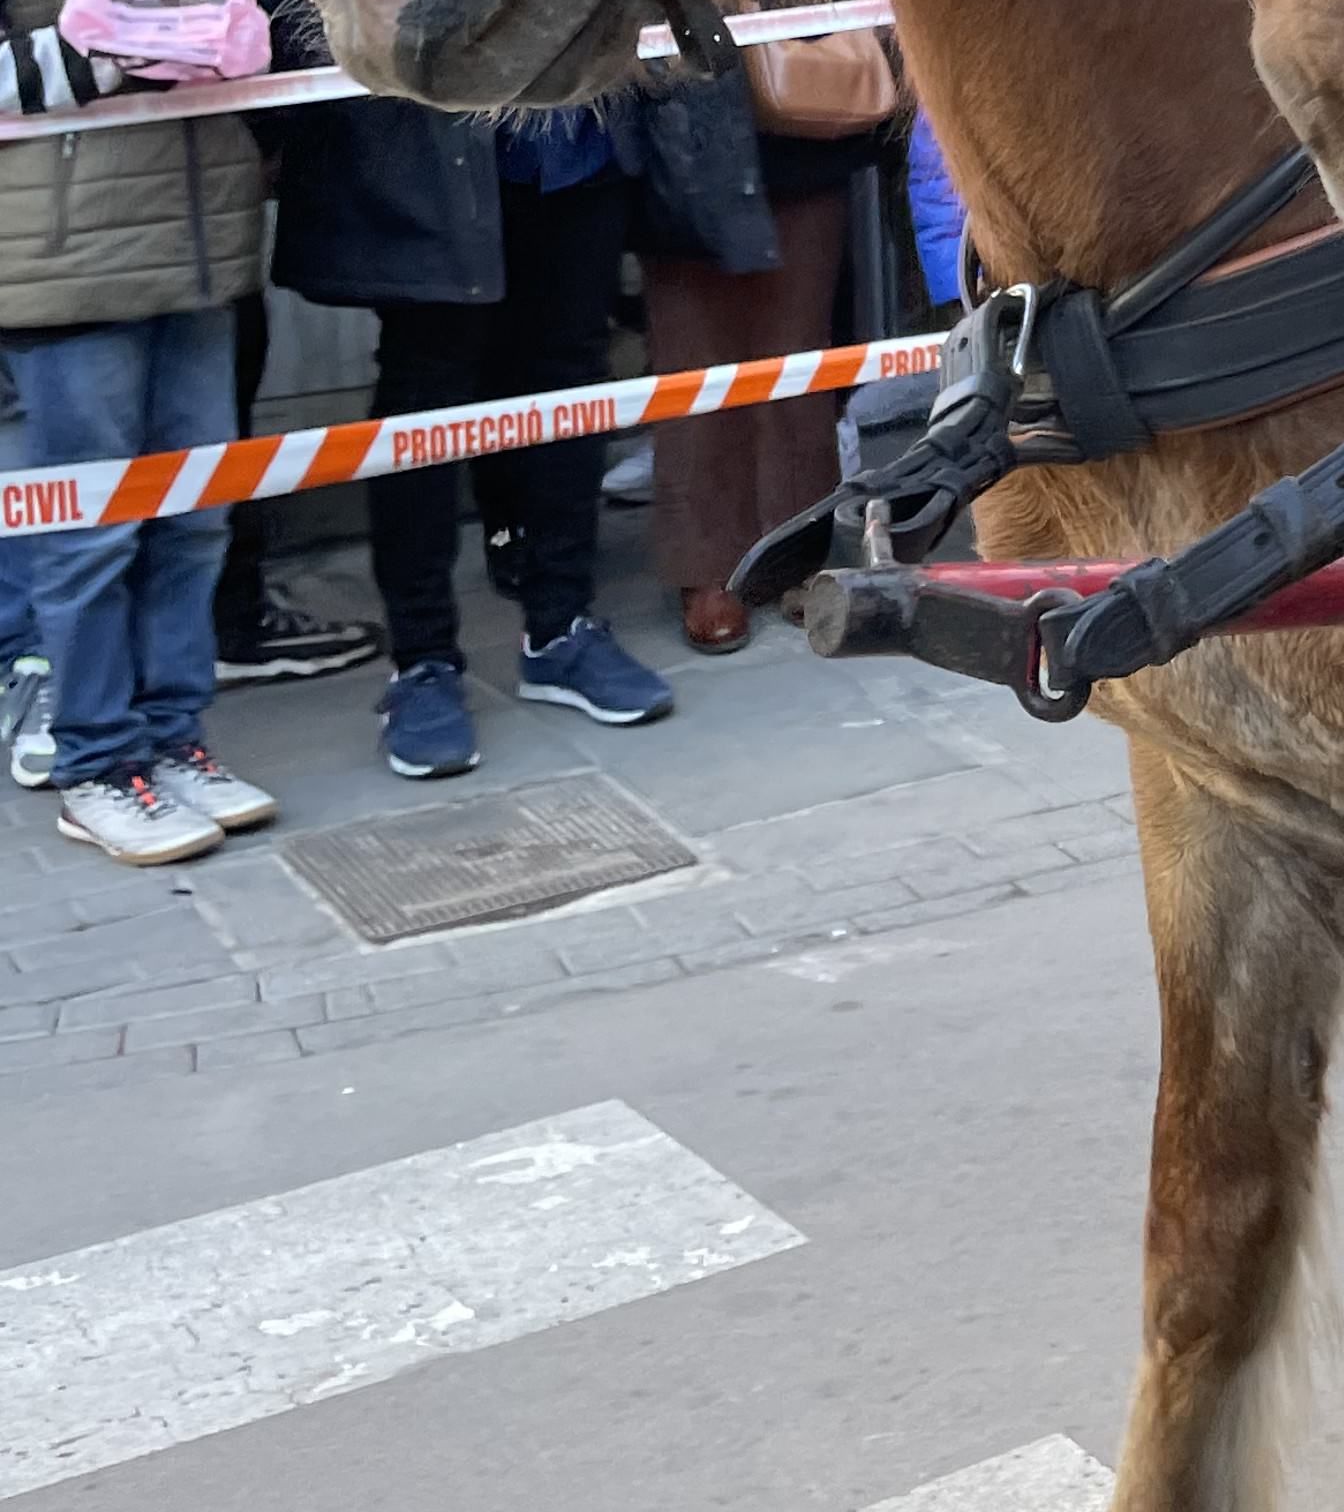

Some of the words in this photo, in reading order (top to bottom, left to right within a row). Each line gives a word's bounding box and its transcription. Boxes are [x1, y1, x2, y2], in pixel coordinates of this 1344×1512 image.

[880, 343, 941, 379] PROT
[393, 400, 544, 468] PROTECCIÓ
[552, 397, 618, 441] CIVIL
[3, 479, 84, 529] CIVIL
